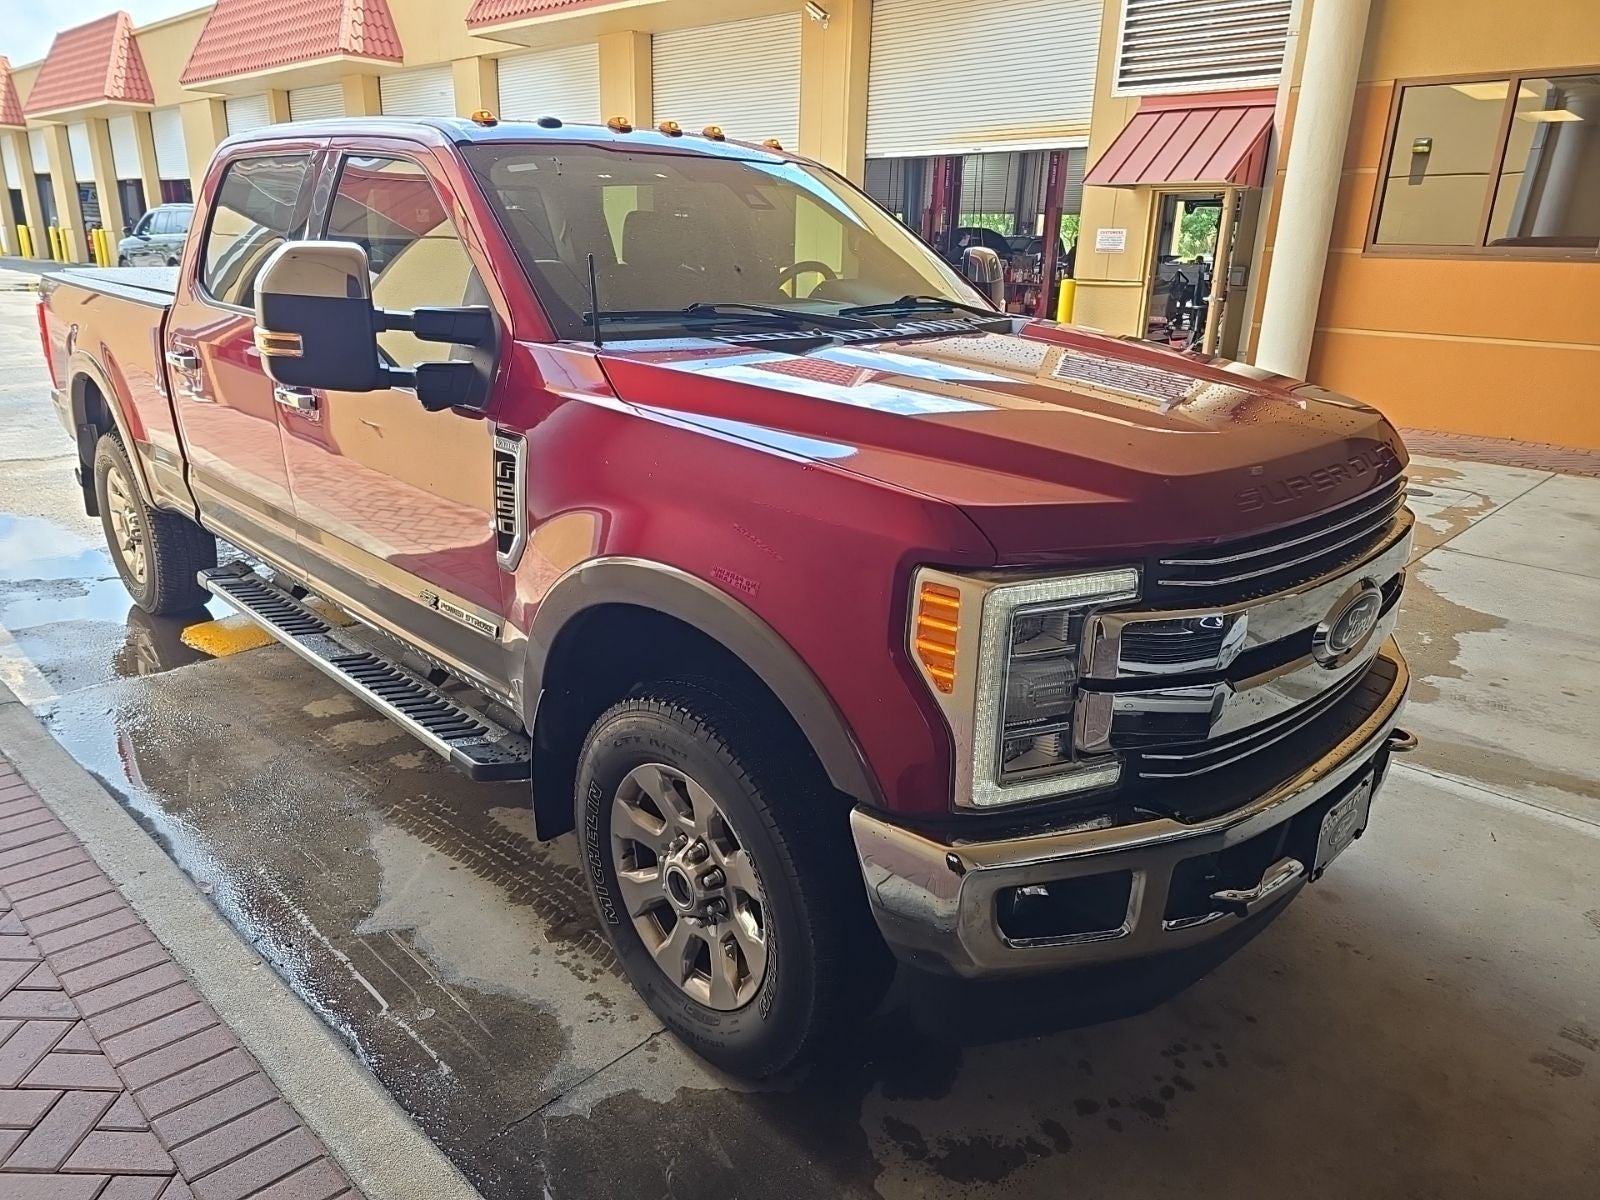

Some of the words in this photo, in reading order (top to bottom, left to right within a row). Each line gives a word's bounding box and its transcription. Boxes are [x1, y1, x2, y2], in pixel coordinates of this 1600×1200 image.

[1235, 463, 1351, 513] SUPER
[440, 601, 465, 618] POWER
[465, 613, 496, 634] STROKE
[1342, 603, 1375, 643] Ford
[586, 780, 619, 926] MICHELIN
